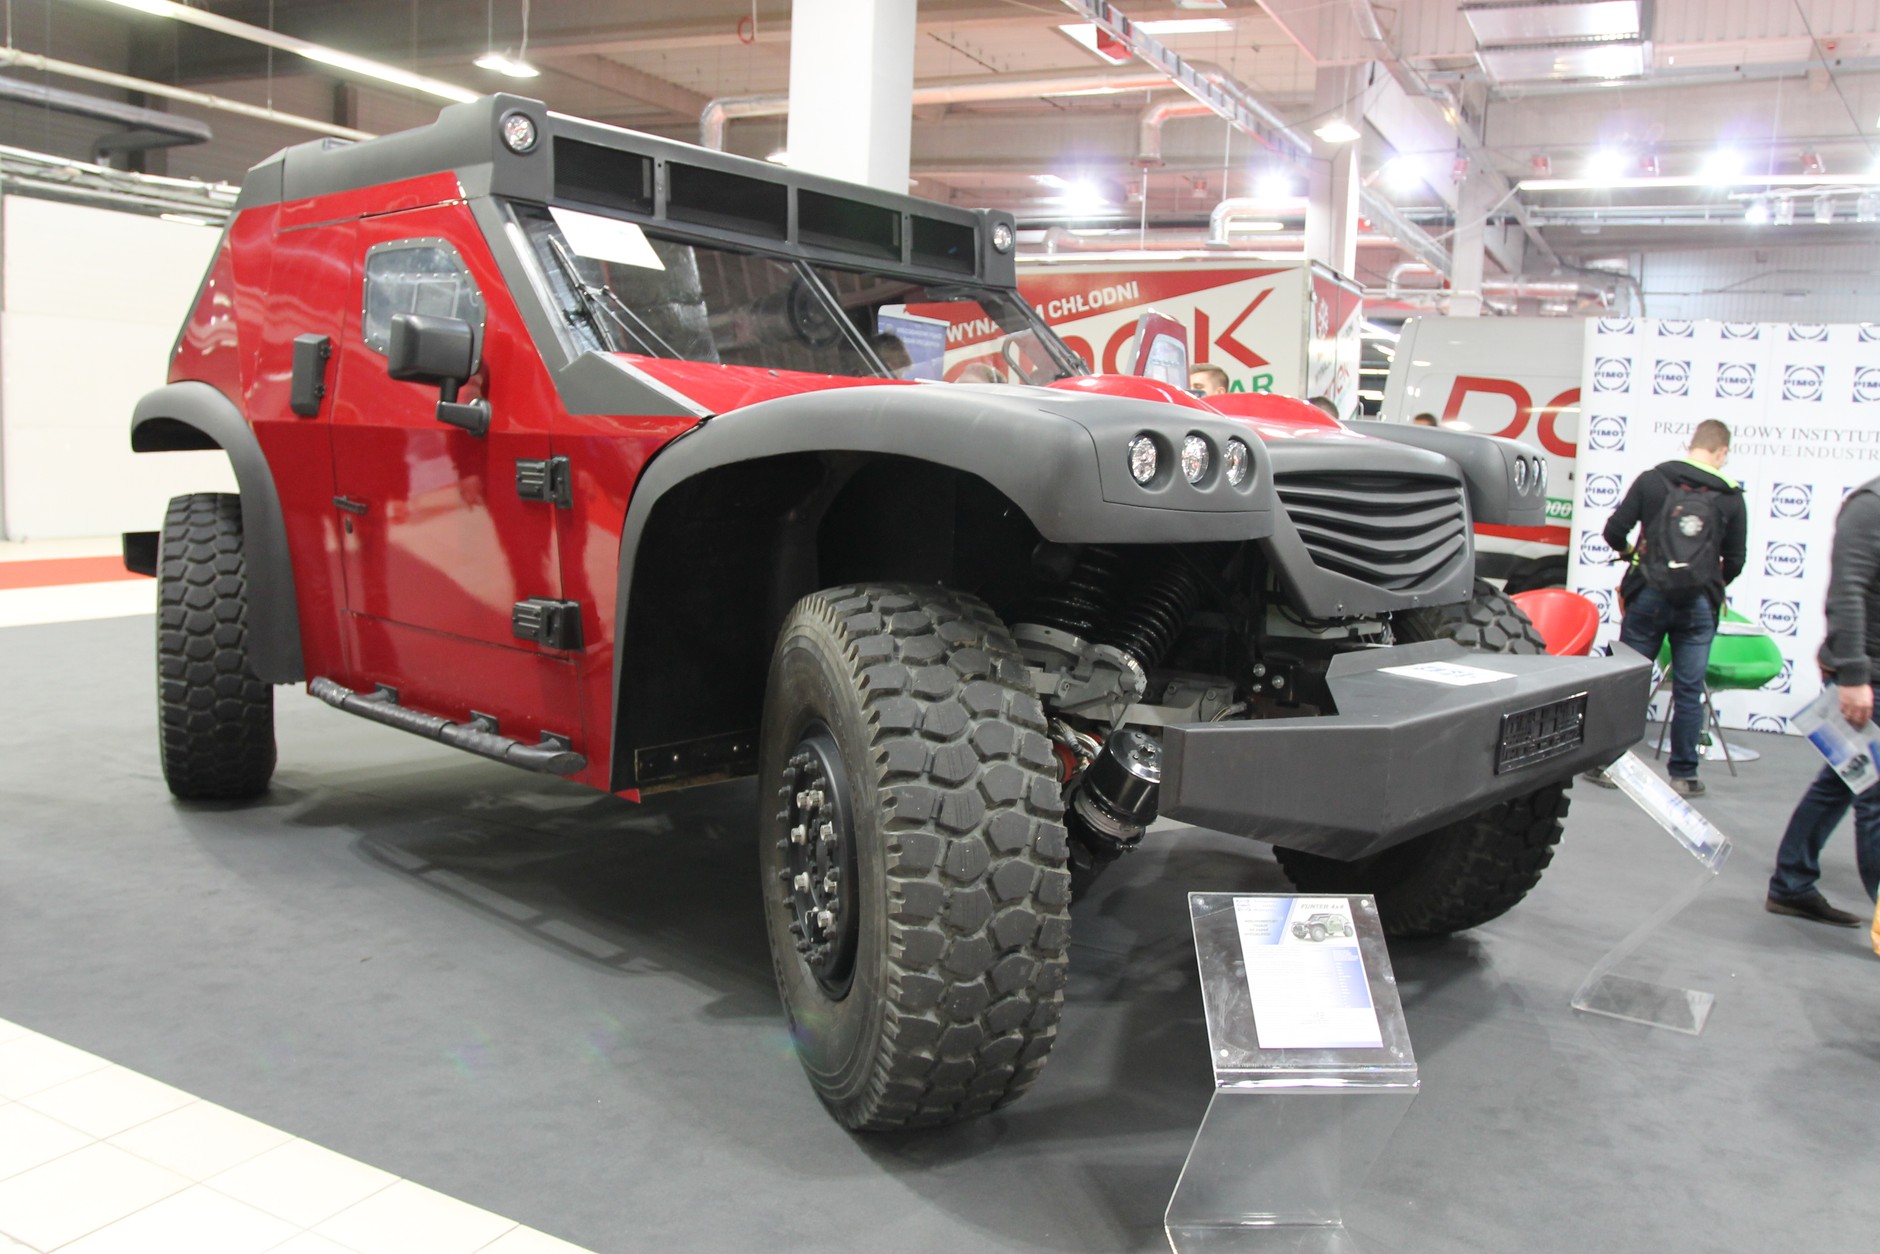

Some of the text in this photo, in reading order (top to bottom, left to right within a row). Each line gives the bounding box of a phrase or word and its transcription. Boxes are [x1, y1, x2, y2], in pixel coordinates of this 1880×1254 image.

[1049, 281, 1139, 318] CHŁODNI
[1654, 374, 1690, 382] PIMOT
[1717, 376, 1754, 384] PIMOT
[1783, 379, 1823, 387] PIMOT
[1590, 429, 1625, 437] PIMOT
[1797, 446, 1880, 460] INDUSTR
[1585, 487, 1620, 495] PIMOT
[1772, 497, 1810, 505] PIMOT
[1766, 555, 1804, 564] PIMOT
[1760, 613, 1797, 621] PIMOT
